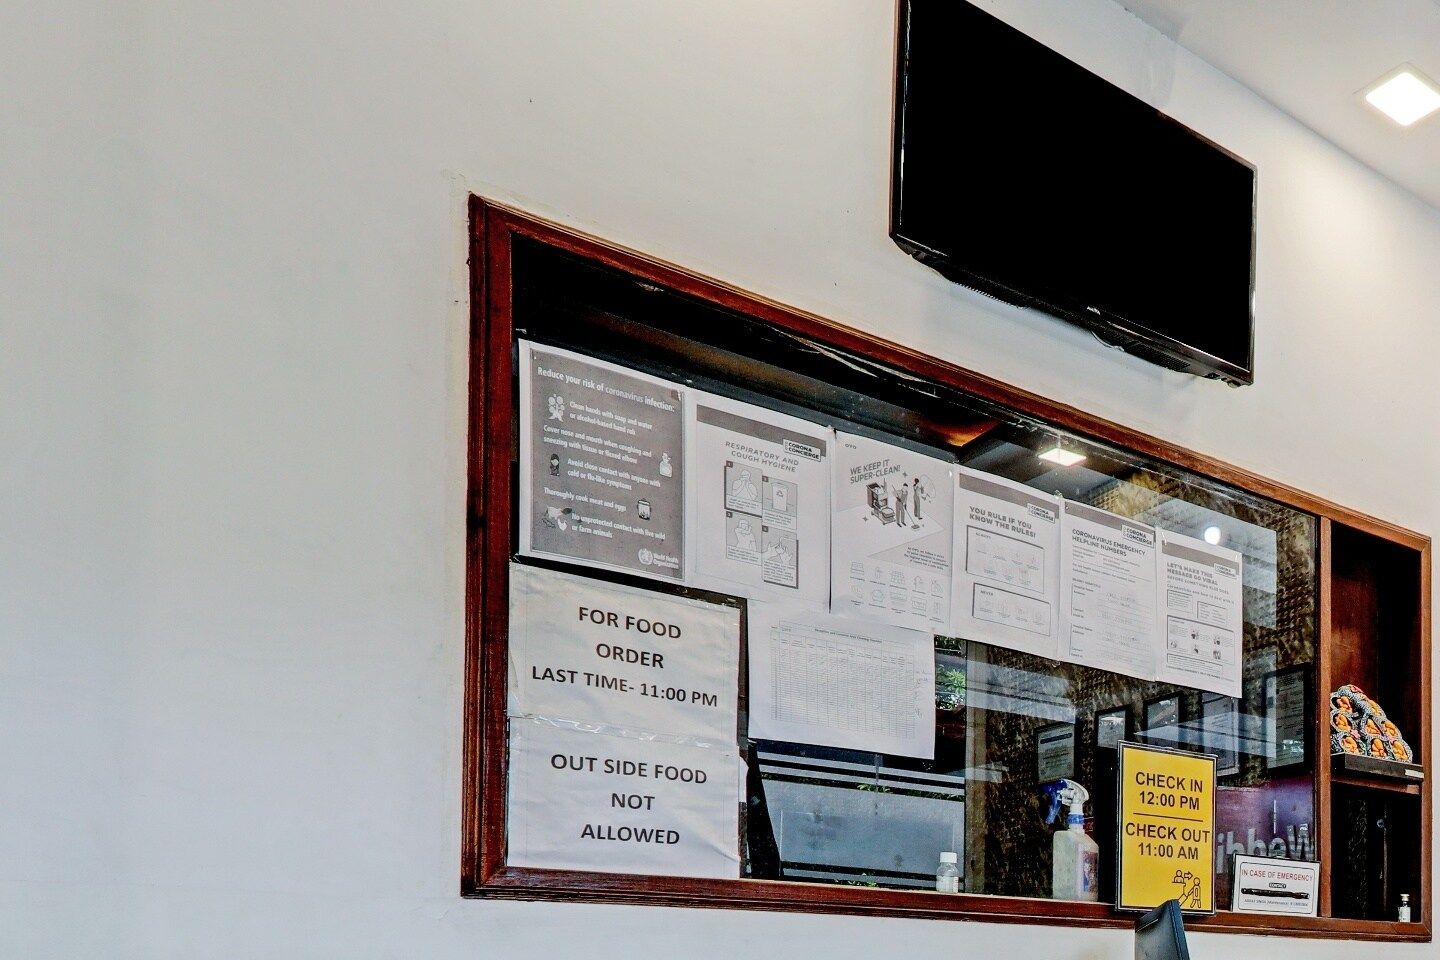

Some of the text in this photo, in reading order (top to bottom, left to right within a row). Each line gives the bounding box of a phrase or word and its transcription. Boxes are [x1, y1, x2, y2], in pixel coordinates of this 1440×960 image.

[538, 367, 674, 412] Reduce your risk of coronavirus infection:
[570, 401, 652, 430] Clean hands with soap and water
[577, 413, 613, 429] alcohol-based
[614, 422, 626, 433] hand
[544, 425, 652, 457] Cover nose and mouth when coughing and
[544, 436, 568, 448] sneezing
[569, 441, 581, 450] with
[582, 444, 597, 454] tissue
[622, 453, 637, 464] elbow
[788, 442, 813, 452] CORONA
[726, 441, 780, 460] RESPIRATORY
[782, 457, 799, 466] AND
[731, 451, 796, 472] COUGH HYGIENE
[788, 448, 820, 459] CONCIERGE
[568, 458, 661, 488] Avoid close contact with anyone with
[850, 459, 890, 475] WE KEEP IT
[850, 465, 900, 484] SUPER-CLEAN!
[568, 470, 579, 478] cold
[588, 472, 605, 484] flu-like
[606, 477, 632, 490] symptoms
[544, 487, 626, 512] Thoroughly cook meat and eggs
[970, 506, 986, 516] YOU
[988, 512, 1006, 522] RULE
[1018, 519, 1032, 529] YOU
[1031, 505, 1049, 515] CORONA
[572, 513, 665, 540] No unprotected contact with live wild
[579, 525, 592, 534] farm
[592, 528, 613, 539] animals
[970, 514, 1036, 538] KNOW THE RULES!
[1127, 528, 1147, 538] CORONA
[1072, 529, 1145, 555] CORONAVIRUS EMERGENCY
[1072, 536, 1127, 556] HELPLINE NUMBERS
[1126, 532, 1152, 545] CONCIERGE
[1167, 562, 1213, 579] LET'S MAKE THIS
[1167, 568, 1192, 578] MESSAGE
[1202, 578, 1218, 586] VIRAL
[579, 607, 681, 639] FOR FOOD
[596, 643, 664, 668] ORDER
[532, 666, 717, 707] LAST TIME- 11:00 PM
[551, 754, 707, 783] OUT SIDE FOOD
[1136, 772, 1203, 793] CHECK IN
[612, 793, 655, 810] NOT
[1139, 791, 1199, 810] 12:00 PM
[581, 824, 680, 844] ALLOWED
[1126, 822, 1210, 843] CHECK OUT
[1138, 842, 1198, 860] 11:00 AM
[1277, 872, 1312, 881] EMERGENCY
